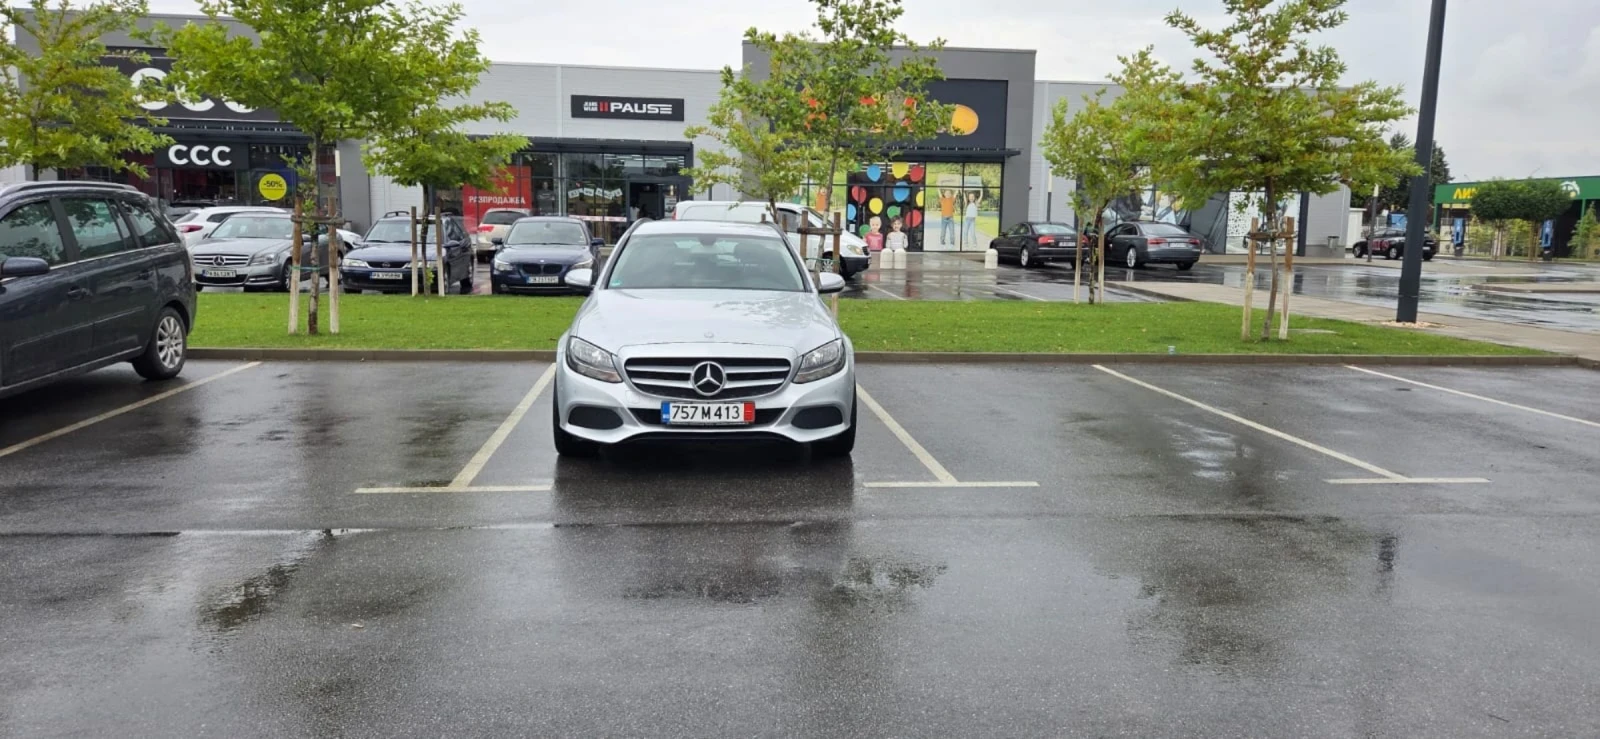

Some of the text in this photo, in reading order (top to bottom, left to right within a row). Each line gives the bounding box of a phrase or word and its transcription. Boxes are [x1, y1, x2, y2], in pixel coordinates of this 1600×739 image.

[610, 102, 672, 114] PAUSE
[168, 144, 232, 166] CCC
[263, 180, 283, 188] -50%
[672, 405, 740, 420] 757 M 413
